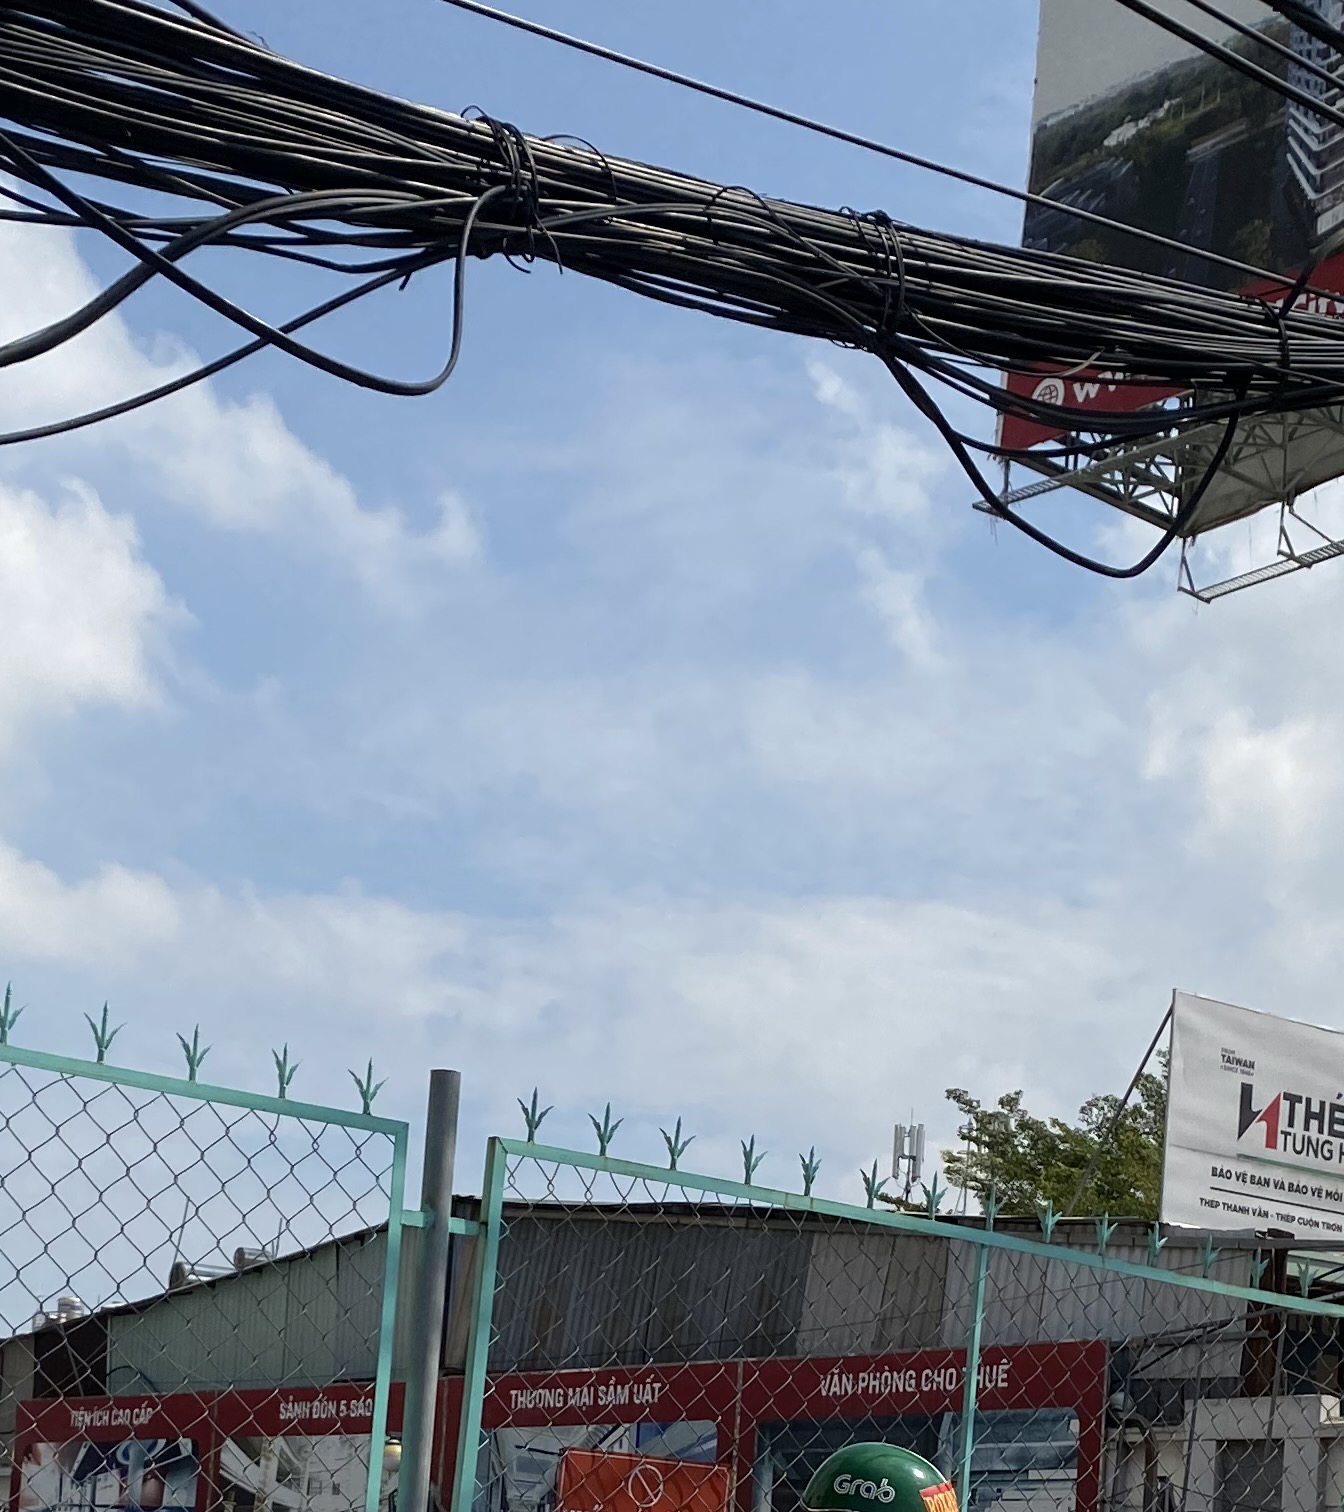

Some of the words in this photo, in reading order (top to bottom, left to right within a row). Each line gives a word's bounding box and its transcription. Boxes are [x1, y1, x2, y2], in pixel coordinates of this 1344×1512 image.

[1221, 1054, 1255, 1070] TAIWAN
[1281, 1129, 1333, 1162] TUNG
[1211, 1164, 1232, 1180] BẢO
[819, 1366, 853, 1396] VĂN
[858, 1365, 916, 1395] PHÒNG
[921, 1368, 956, 1392] CHO
[279, 1395, 310, 1419] SẢNH
[340, 1400, 347, 1417] 5
[350, 1399, 372, 1417] SAO
[510, 1388, 564, 1409] THƯƠNG
[111, 1408, 130, 1425] CAO
[833, 1473, 896, 1504] Grab
